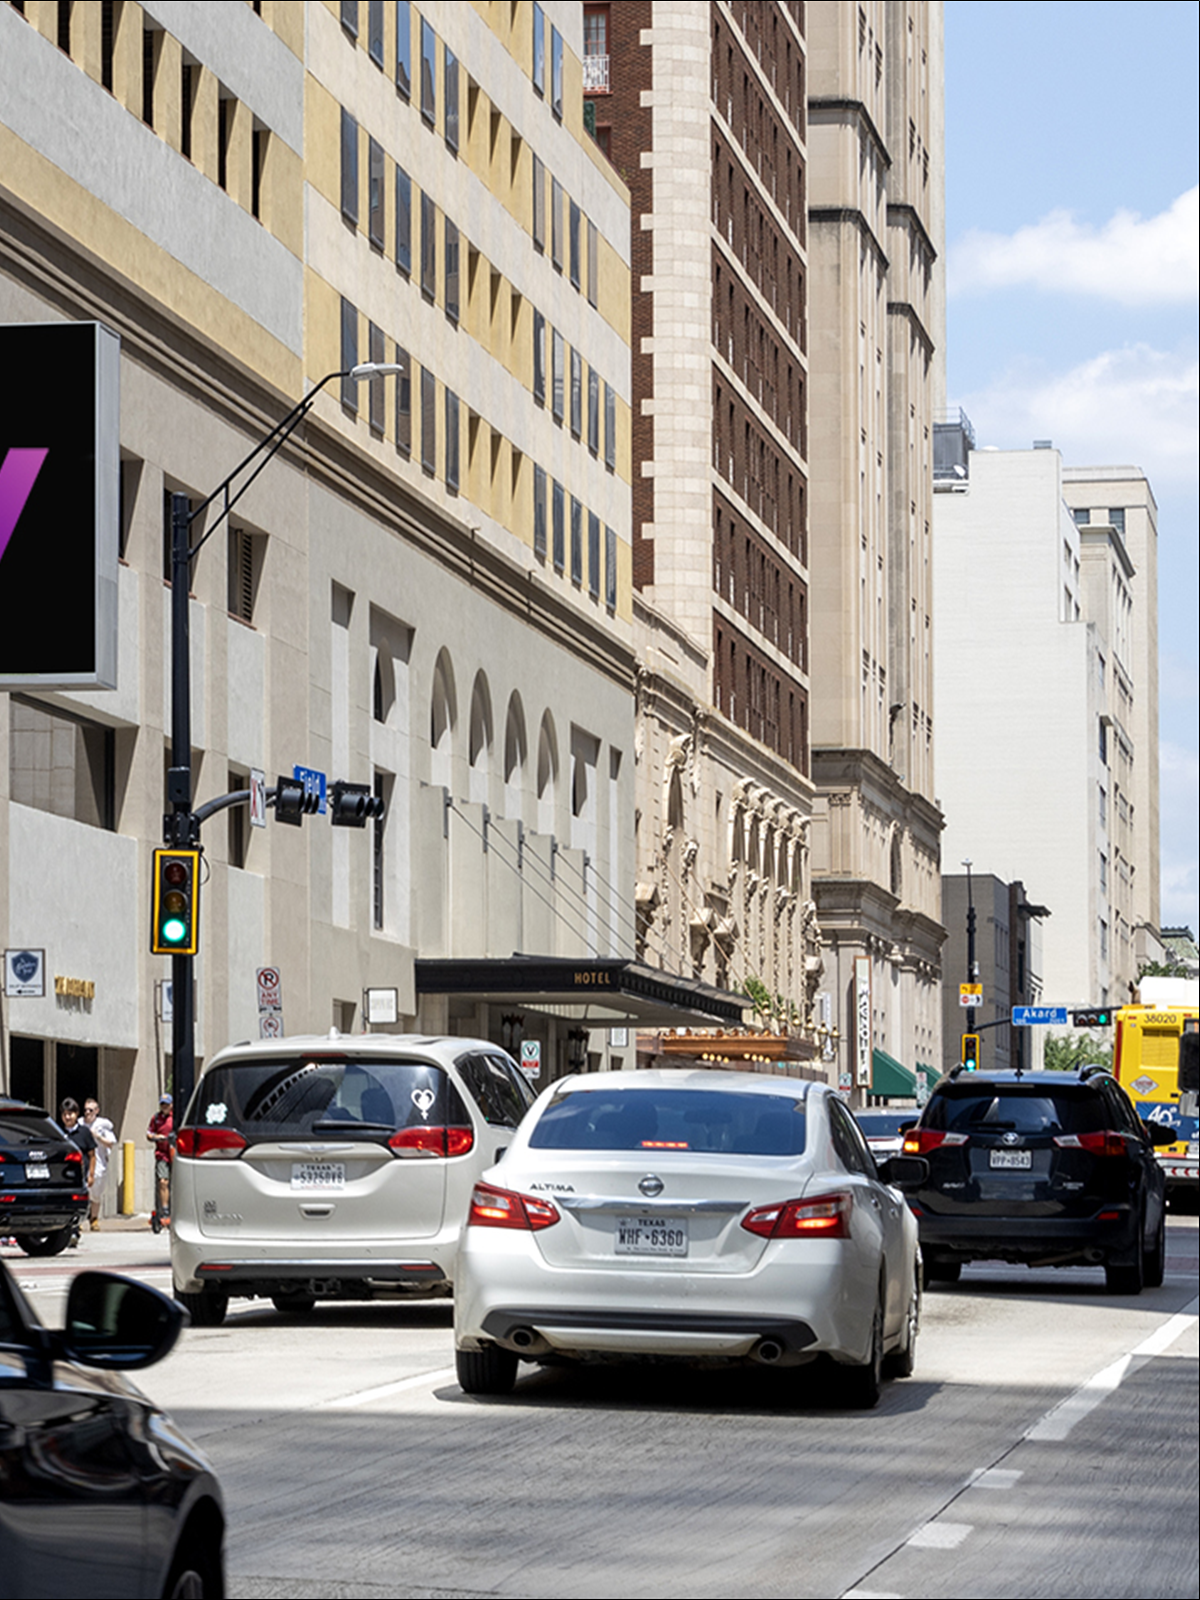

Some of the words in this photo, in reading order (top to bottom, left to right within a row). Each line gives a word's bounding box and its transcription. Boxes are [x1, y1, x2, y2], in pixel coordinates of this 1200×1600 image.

[574, 971, 611, 985] HOTEL
[1022, 1008, 1058, 1019] Akard
[1144, 1012, 1178, 1024] 38020
[530, 1182, 576, 1193] ALTIMA
[637, 1218, 666, 1227] TEXAS
